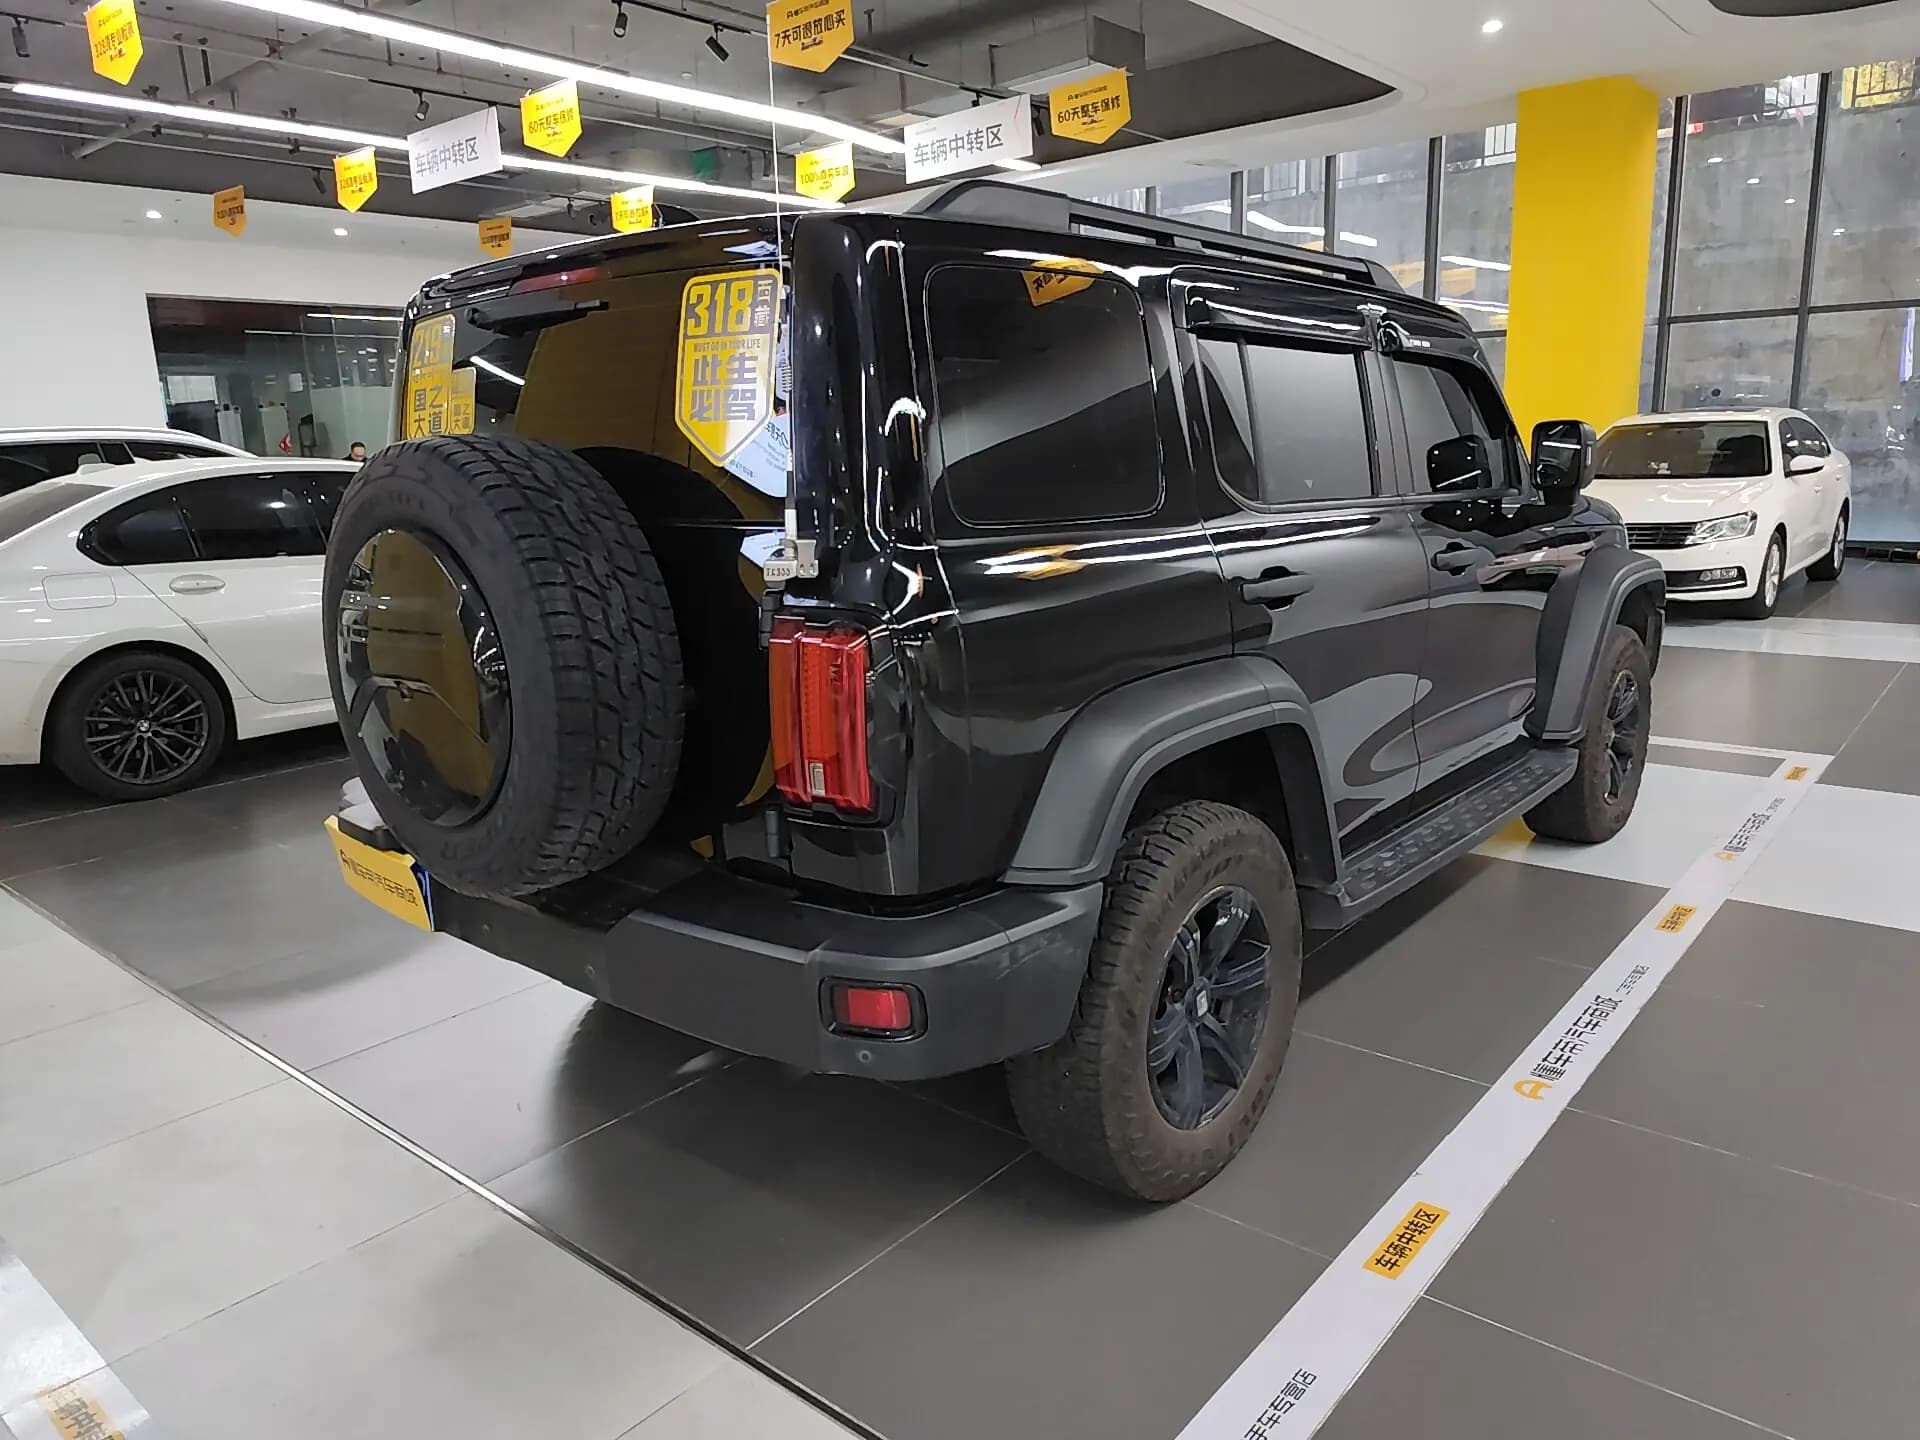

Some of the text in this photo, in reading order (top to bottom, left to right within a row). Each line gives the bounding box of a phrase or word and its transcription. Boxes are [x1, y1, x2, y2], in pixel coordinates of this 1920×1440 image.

[774, 9, 846, 49] 7天可退放心买
[1057, 95, 1121, 123] 60天整车保修
[415, 136, 479, 176] 车辆中转区
[912, 123, 1004, 166] 车辆中转区
[687, 280, 754, 336] 318
[746, 338, 761, 349] LIFE
[691, 352, 758, 386] 此生
[413, 410, 444, 438] 大道
[689, 388, 757, 421] 必驾
[1530, 994, 1623, 1081] 懂车帝汽车商城
[1374, 1207, 1441, 1271] 车辆中转区
